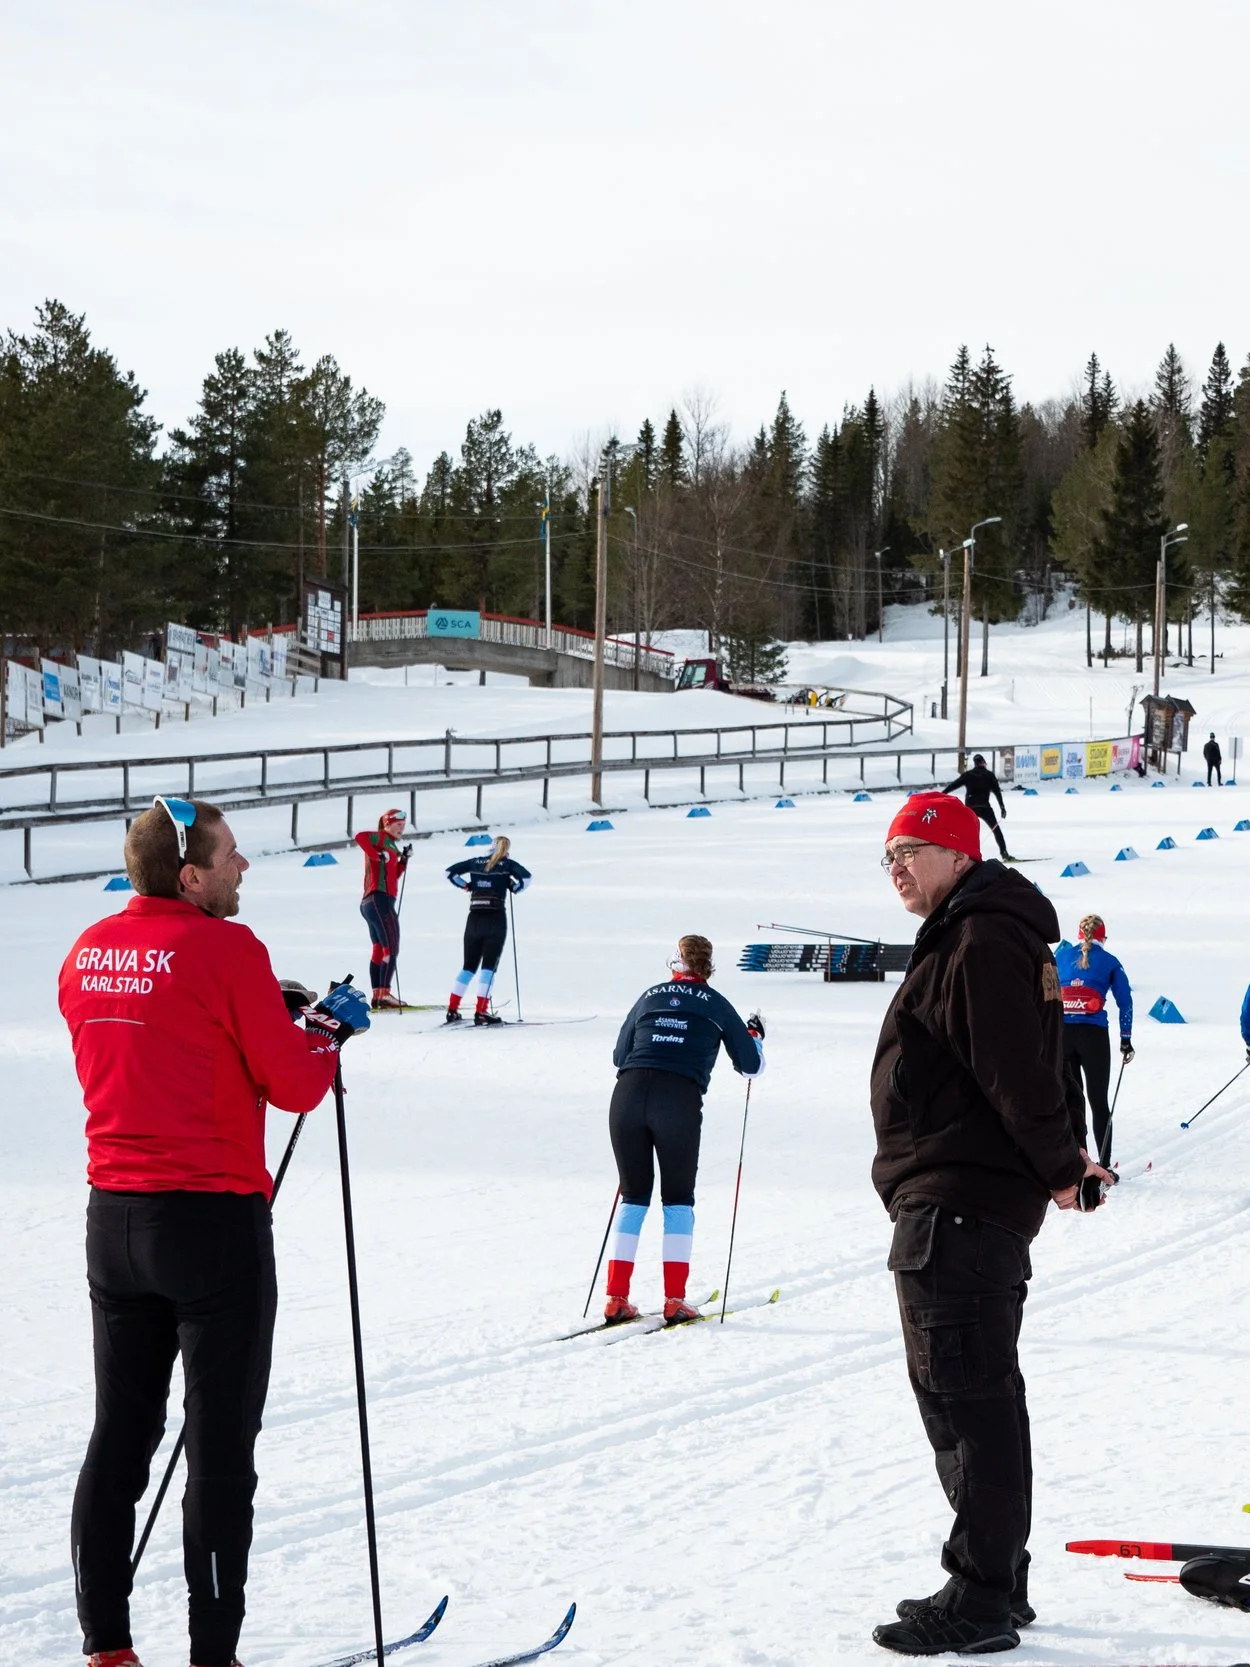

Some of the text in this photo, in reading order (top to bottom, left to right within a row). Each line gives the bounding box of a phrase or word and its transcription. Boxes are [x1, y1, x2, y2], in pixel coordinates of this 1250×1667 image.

[451, 620, 472, 629] SCA
[76, 948, 175, 973] GRAVA SK
[81, 975, 153, 994] KARLSTAD
[696, 989, 711, 1001] IK
